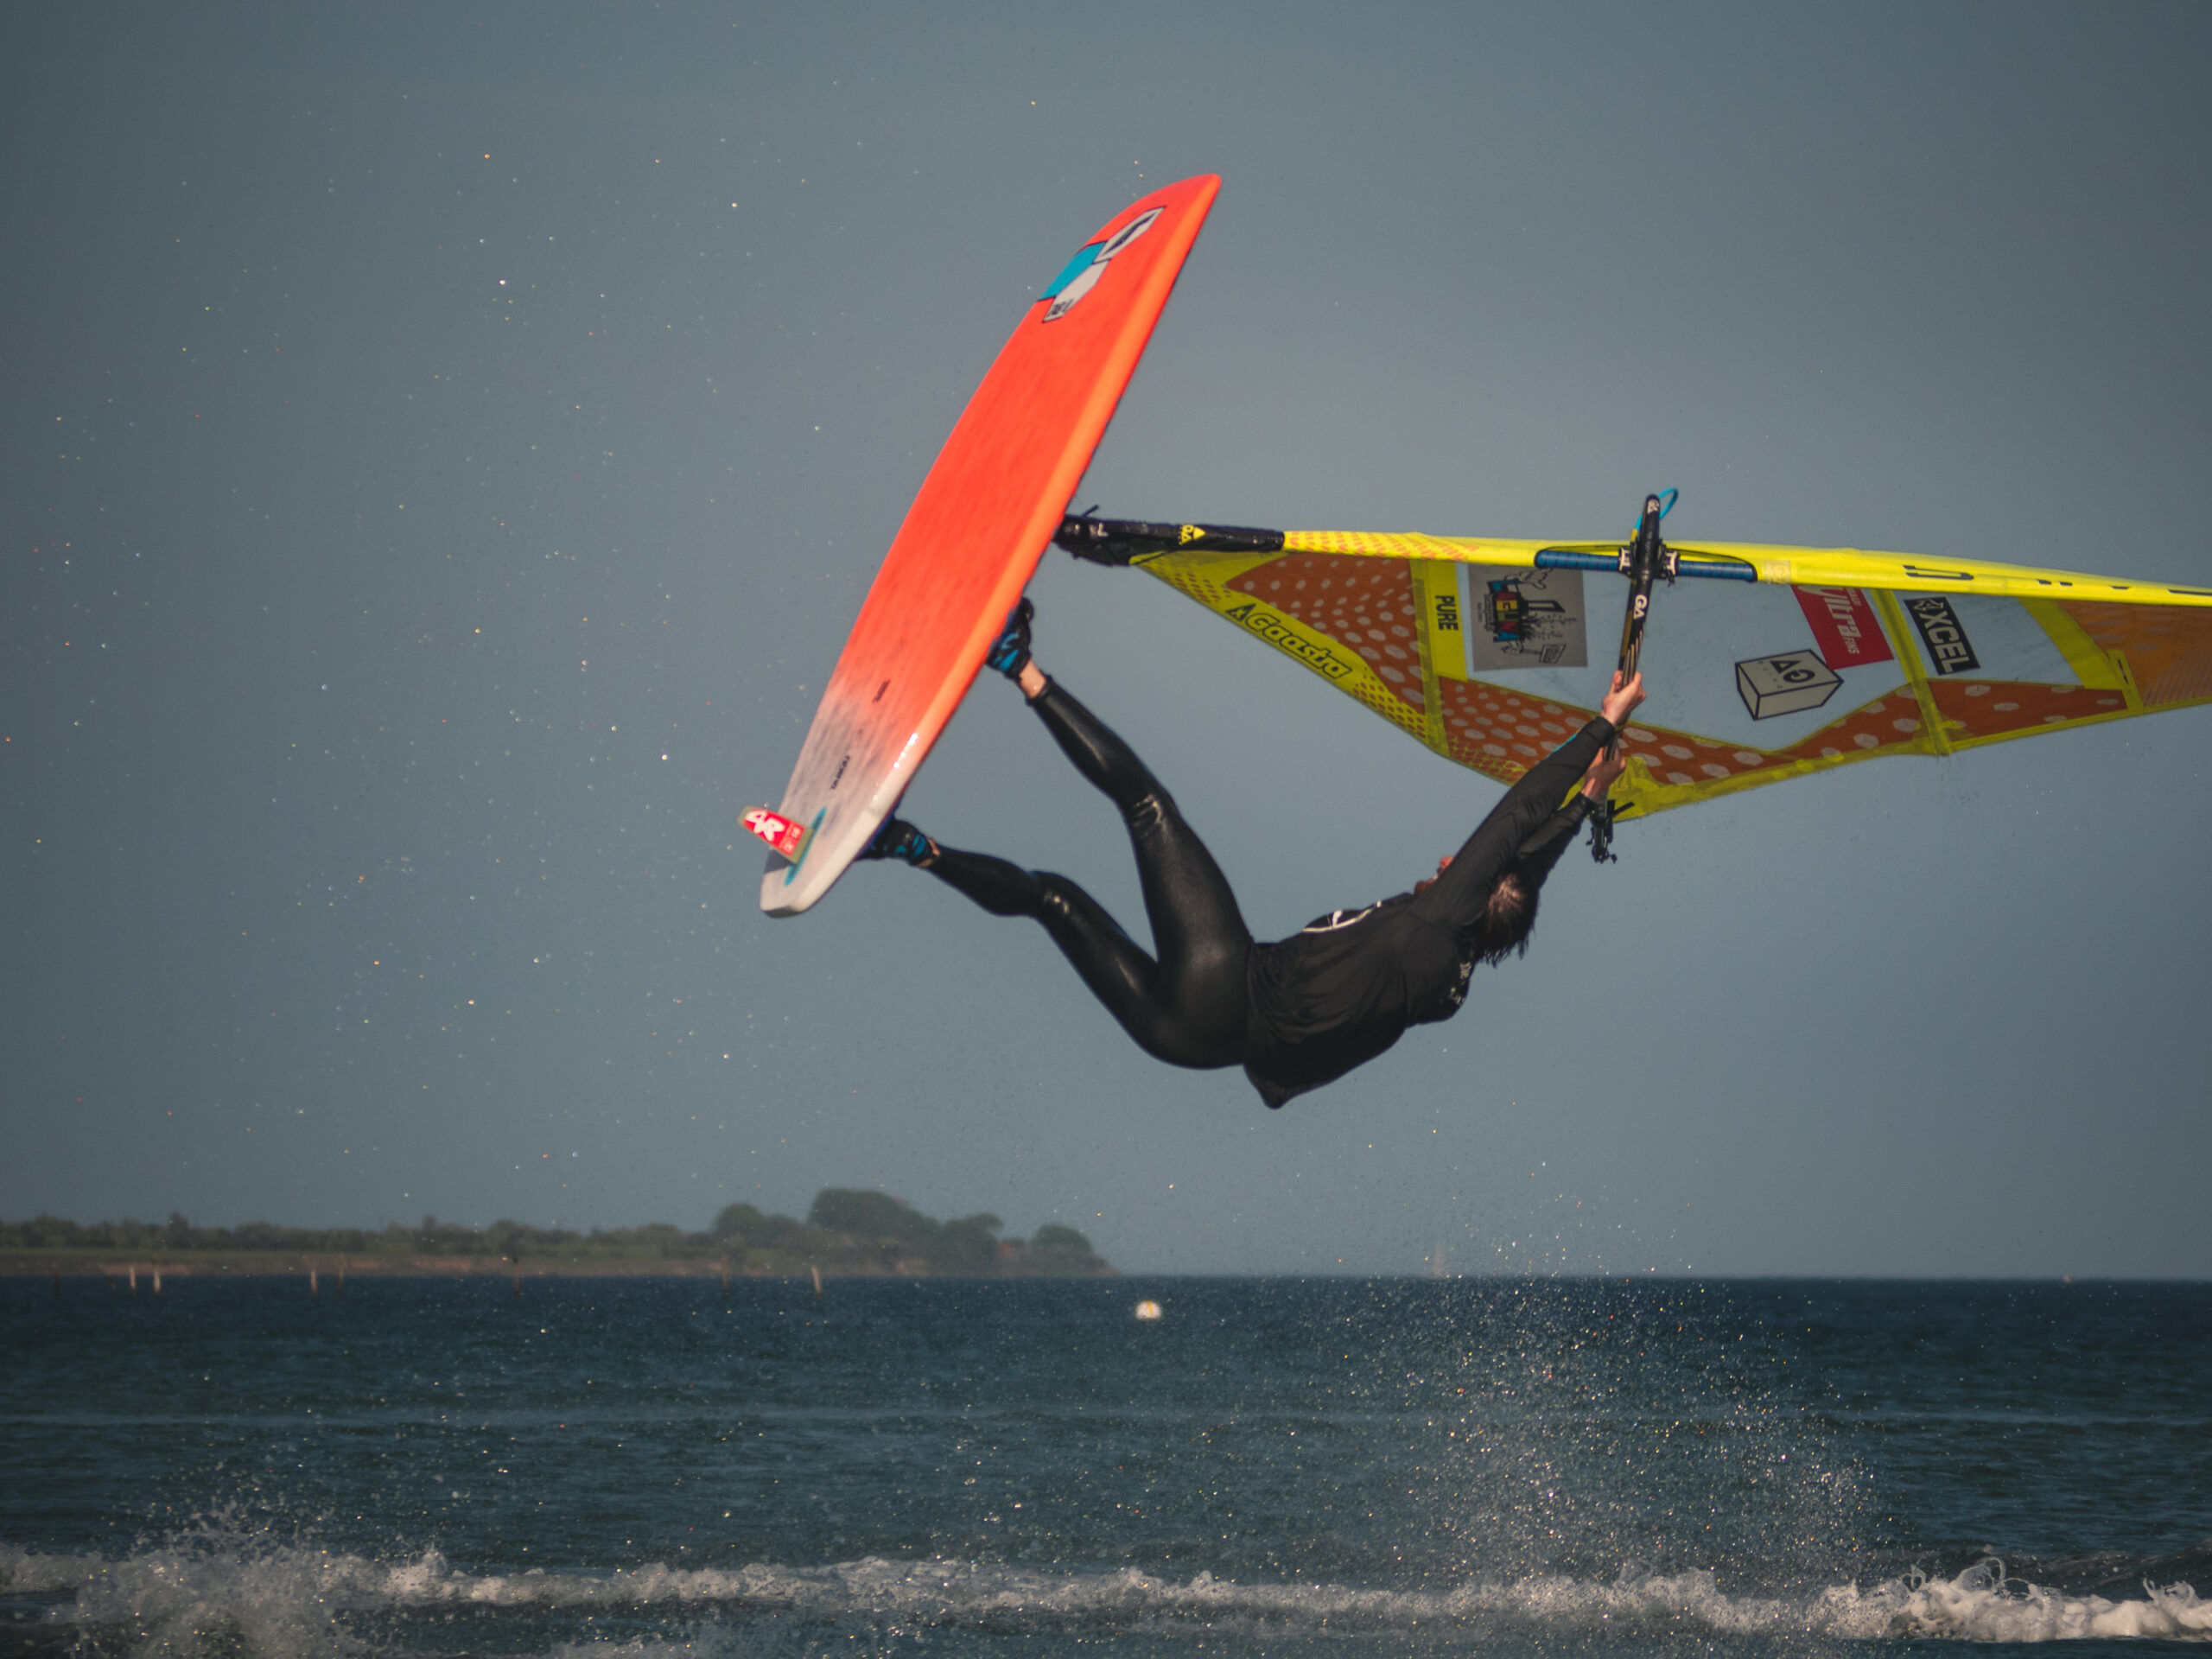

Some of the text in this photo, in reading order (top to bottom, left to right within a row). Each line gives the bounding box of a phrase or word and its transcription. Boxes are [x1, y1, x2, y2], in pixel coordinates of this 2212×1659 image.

[1435, 595, 1459, 630] PURE
[1634, 594, 1648, 620] GA
[1246, 613, 1351, 679] Gaastra
[1920, 611, 1971, 672] XCEL
